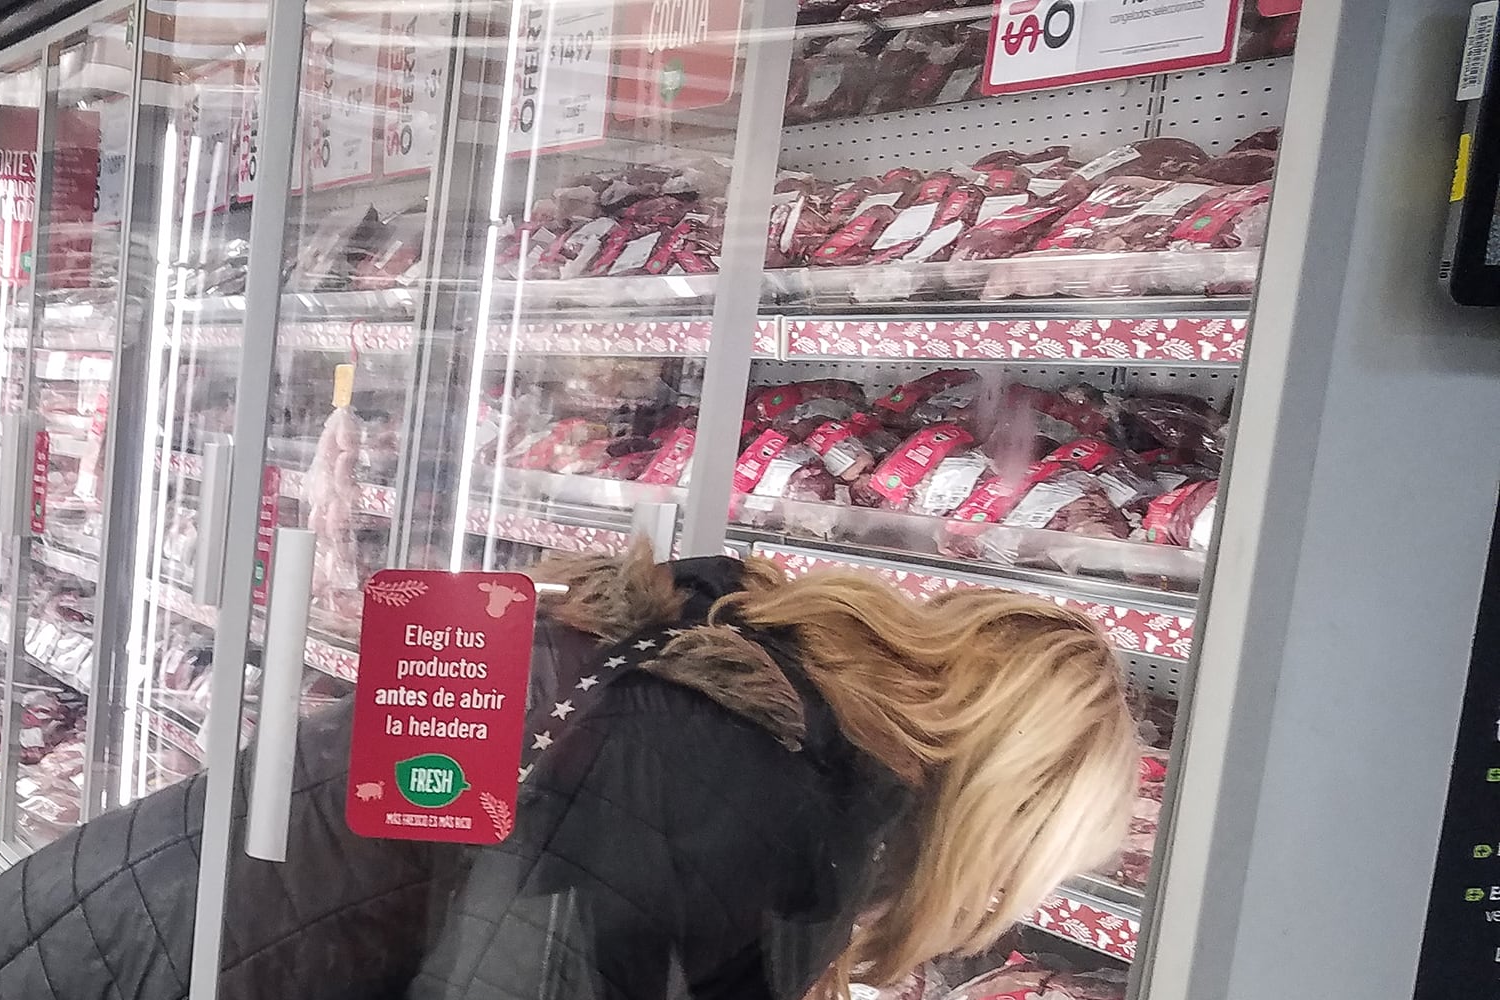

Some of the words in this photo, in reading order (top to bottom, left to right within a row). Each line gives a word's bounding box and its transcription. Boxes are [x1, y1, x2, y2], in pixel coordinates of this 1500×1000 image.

[519, 8, 543, 133] OFERT
[404, 624, 452, 651] Elegí
[455, 627, 486, 648] tus
[397, 656, 488, 680] productos
[375, 686, 428, 707] antes
[432, 687, 455, 708] de
[459, 688, 506, 710] abrir
[385, 714, 403, 735] la
[408, 715, 488, 739] heladera
[409, 768, 454, 794] FRESH
